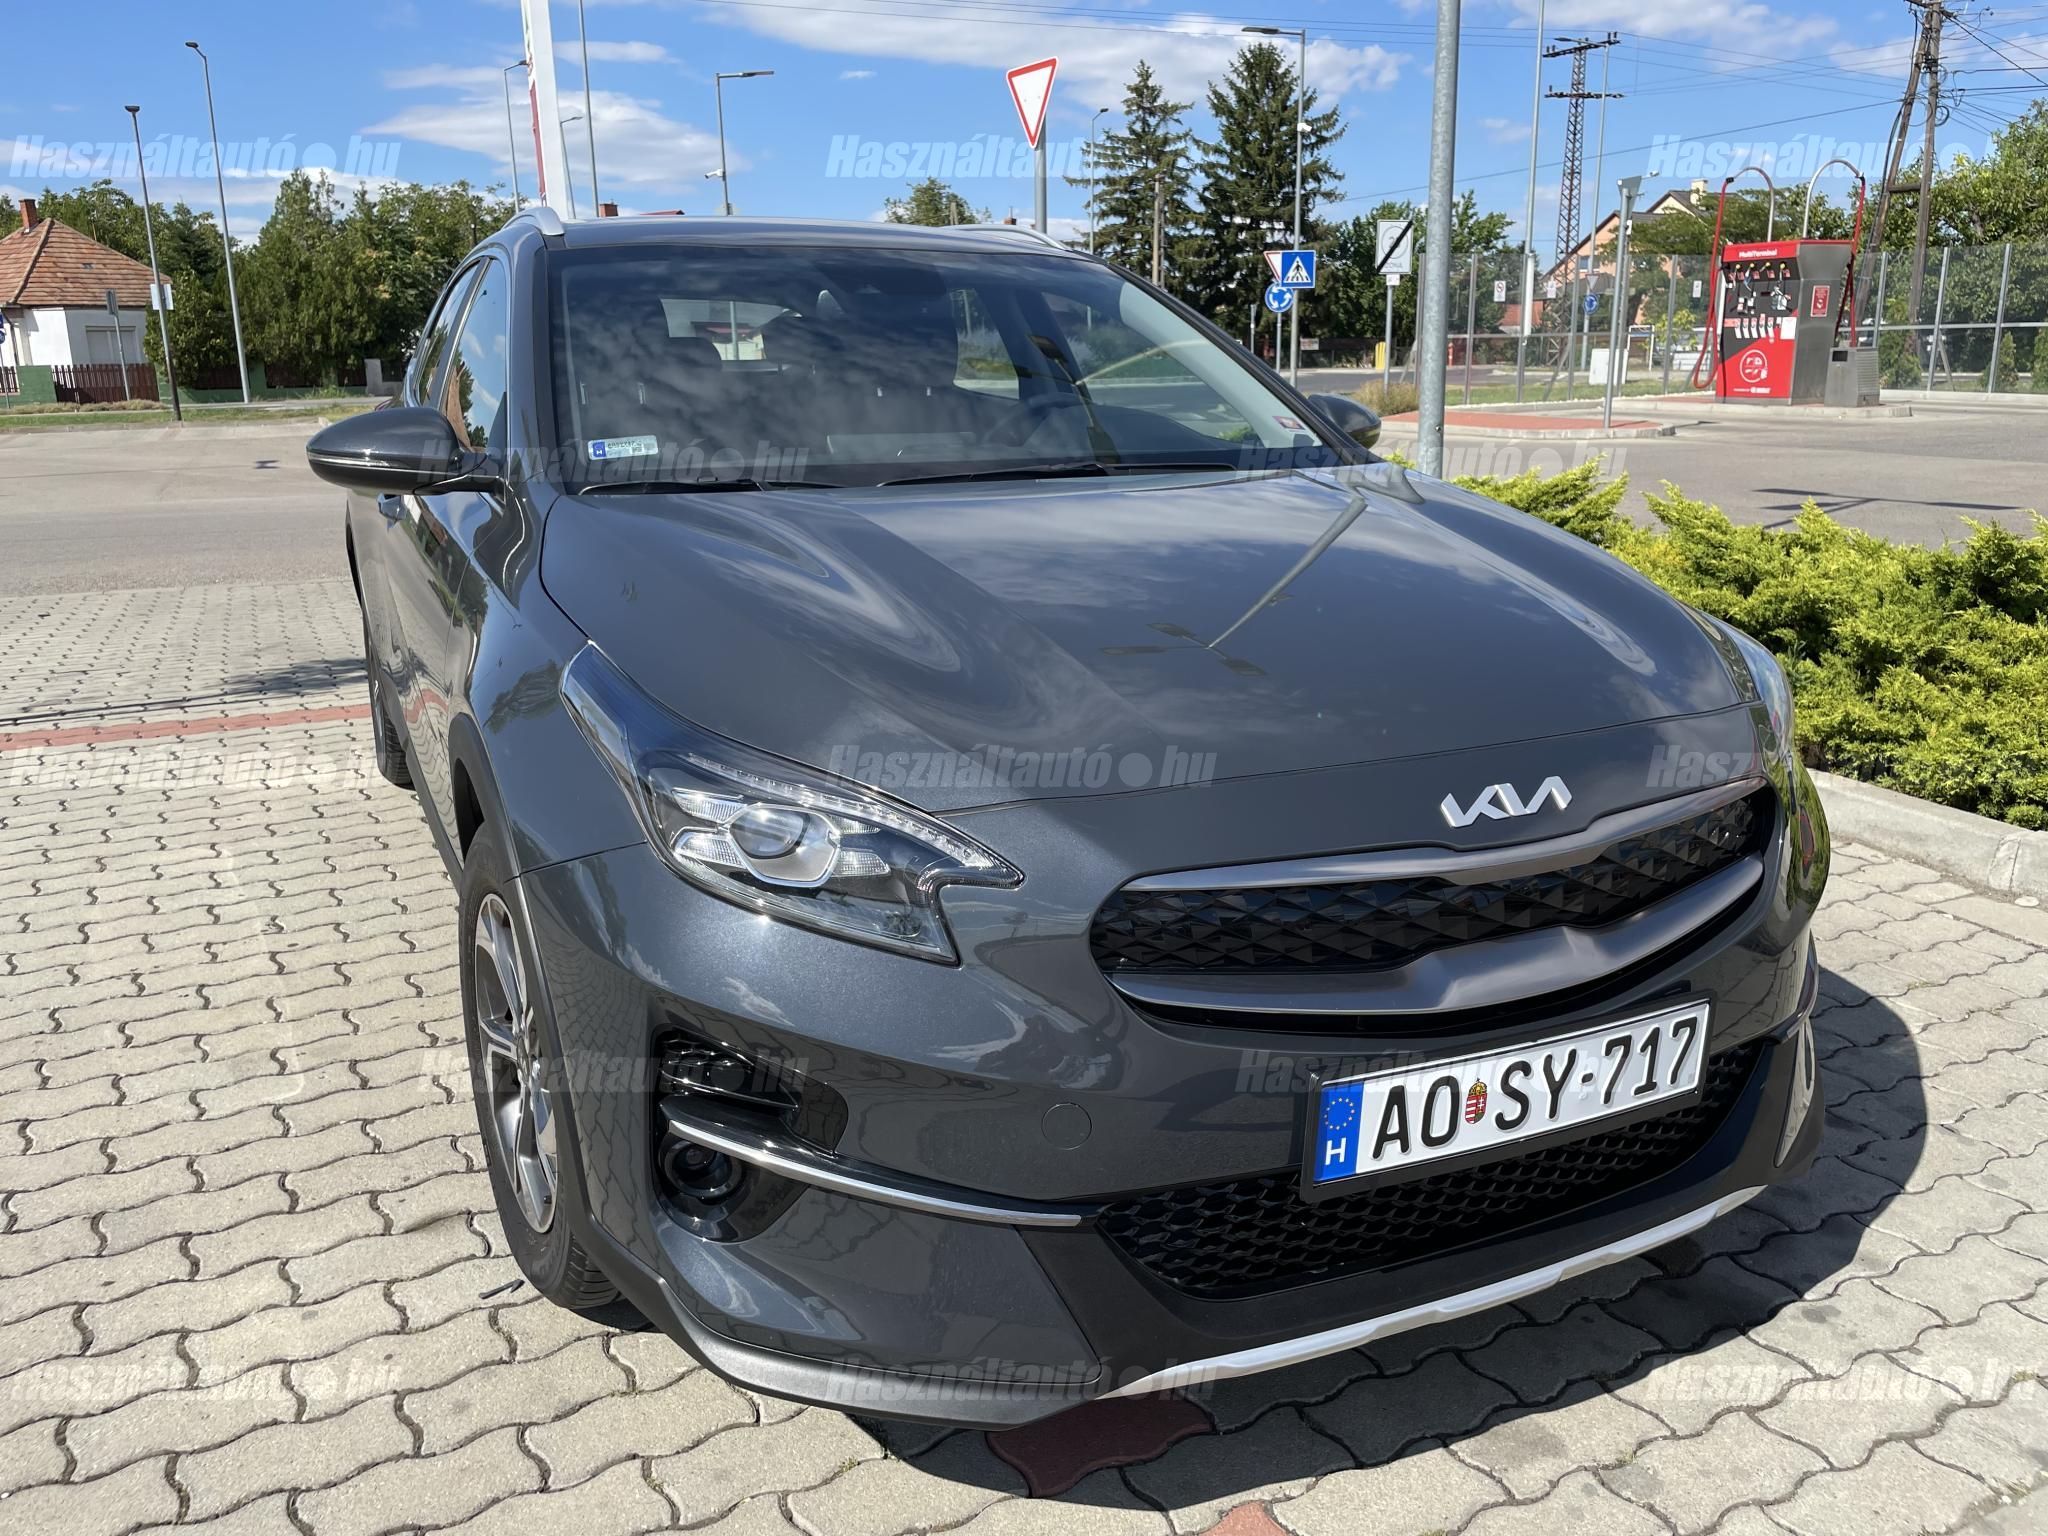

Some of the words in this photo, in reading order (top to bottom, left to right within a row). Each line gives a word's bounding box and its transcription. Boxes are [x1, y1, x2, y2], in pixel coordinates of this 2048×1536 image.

[1441, 776, 1572, 828] KIA
[1372, 1075, 1460, 1160] AO
[1325, 1137, 1347, 1166] H
